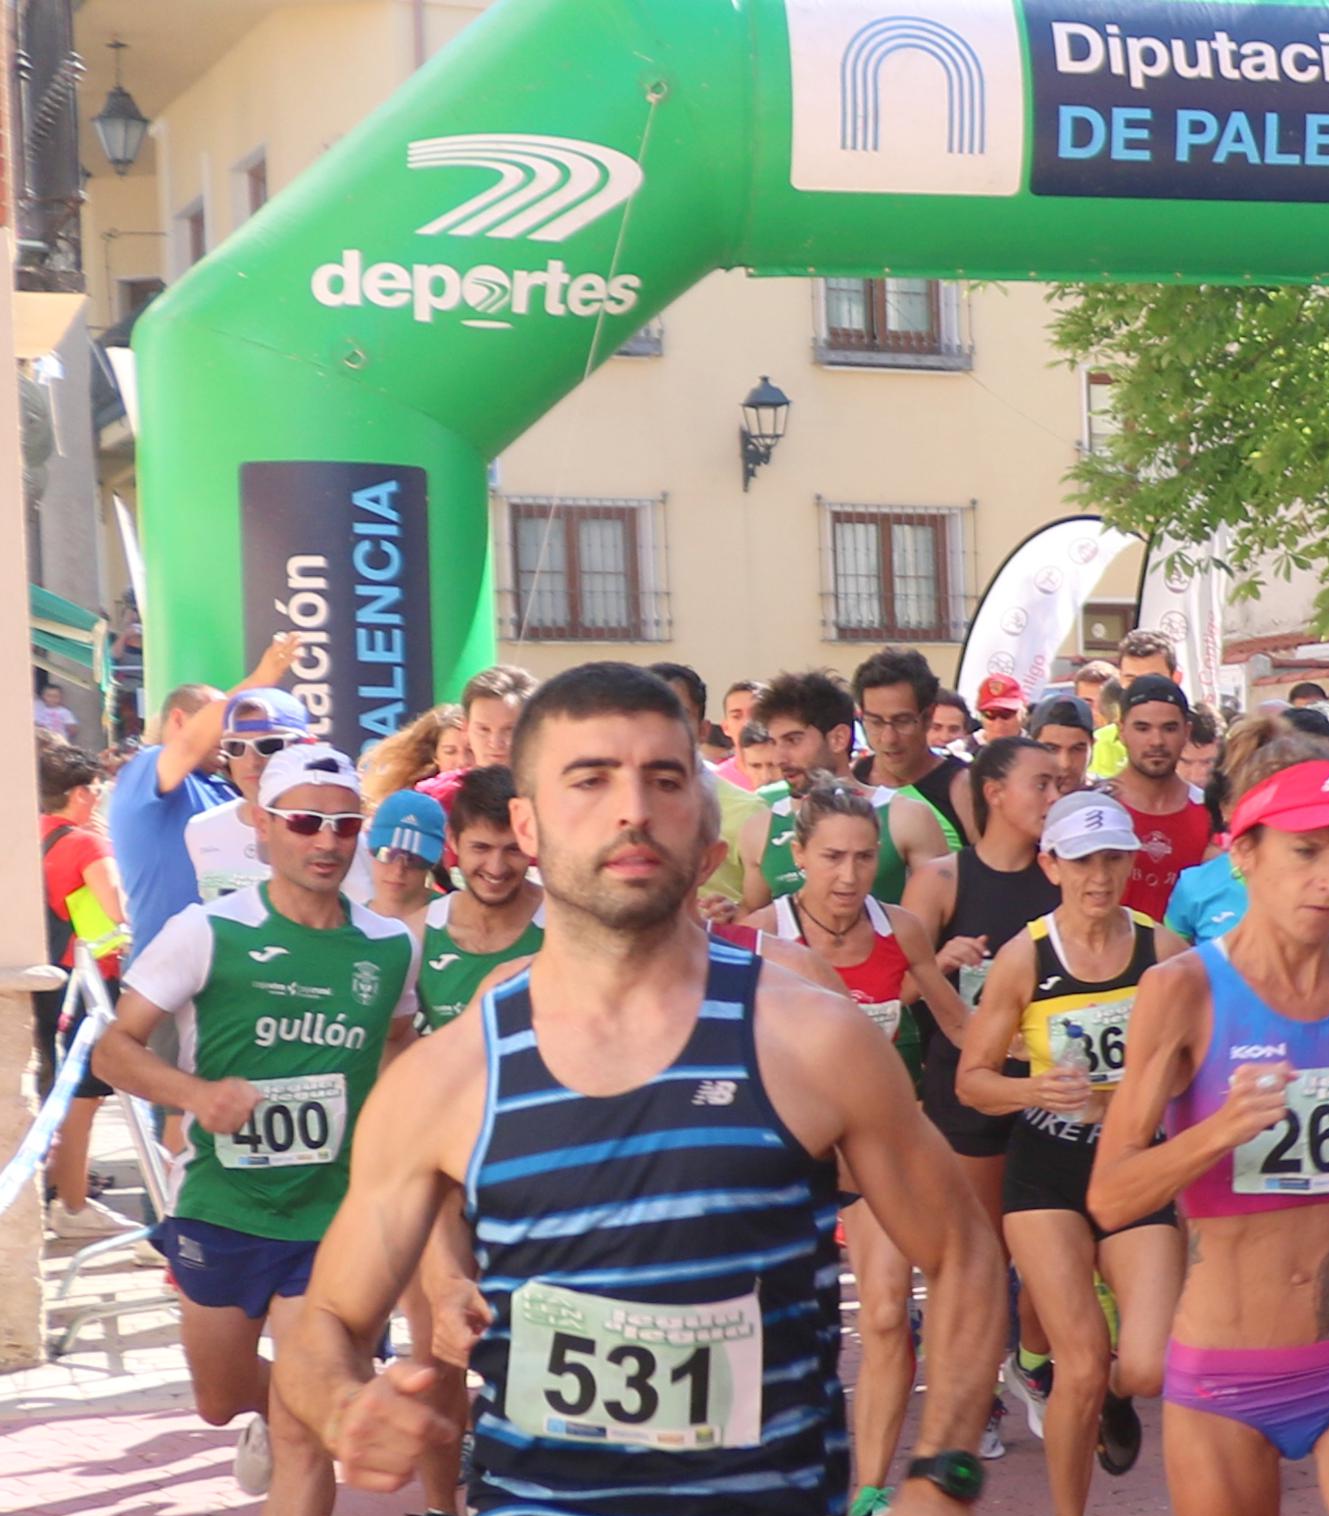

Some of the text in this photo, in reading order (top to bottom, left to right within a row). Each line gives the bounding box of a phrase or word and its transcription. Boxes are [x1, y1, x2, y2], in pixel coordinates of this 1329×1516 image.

[1058, 105, 1152, 161] DE
[311, 249, 642, 323] deportes
[255, 1011, 366, 1049] gullón
[543, 1331, 712, 1425] 531
